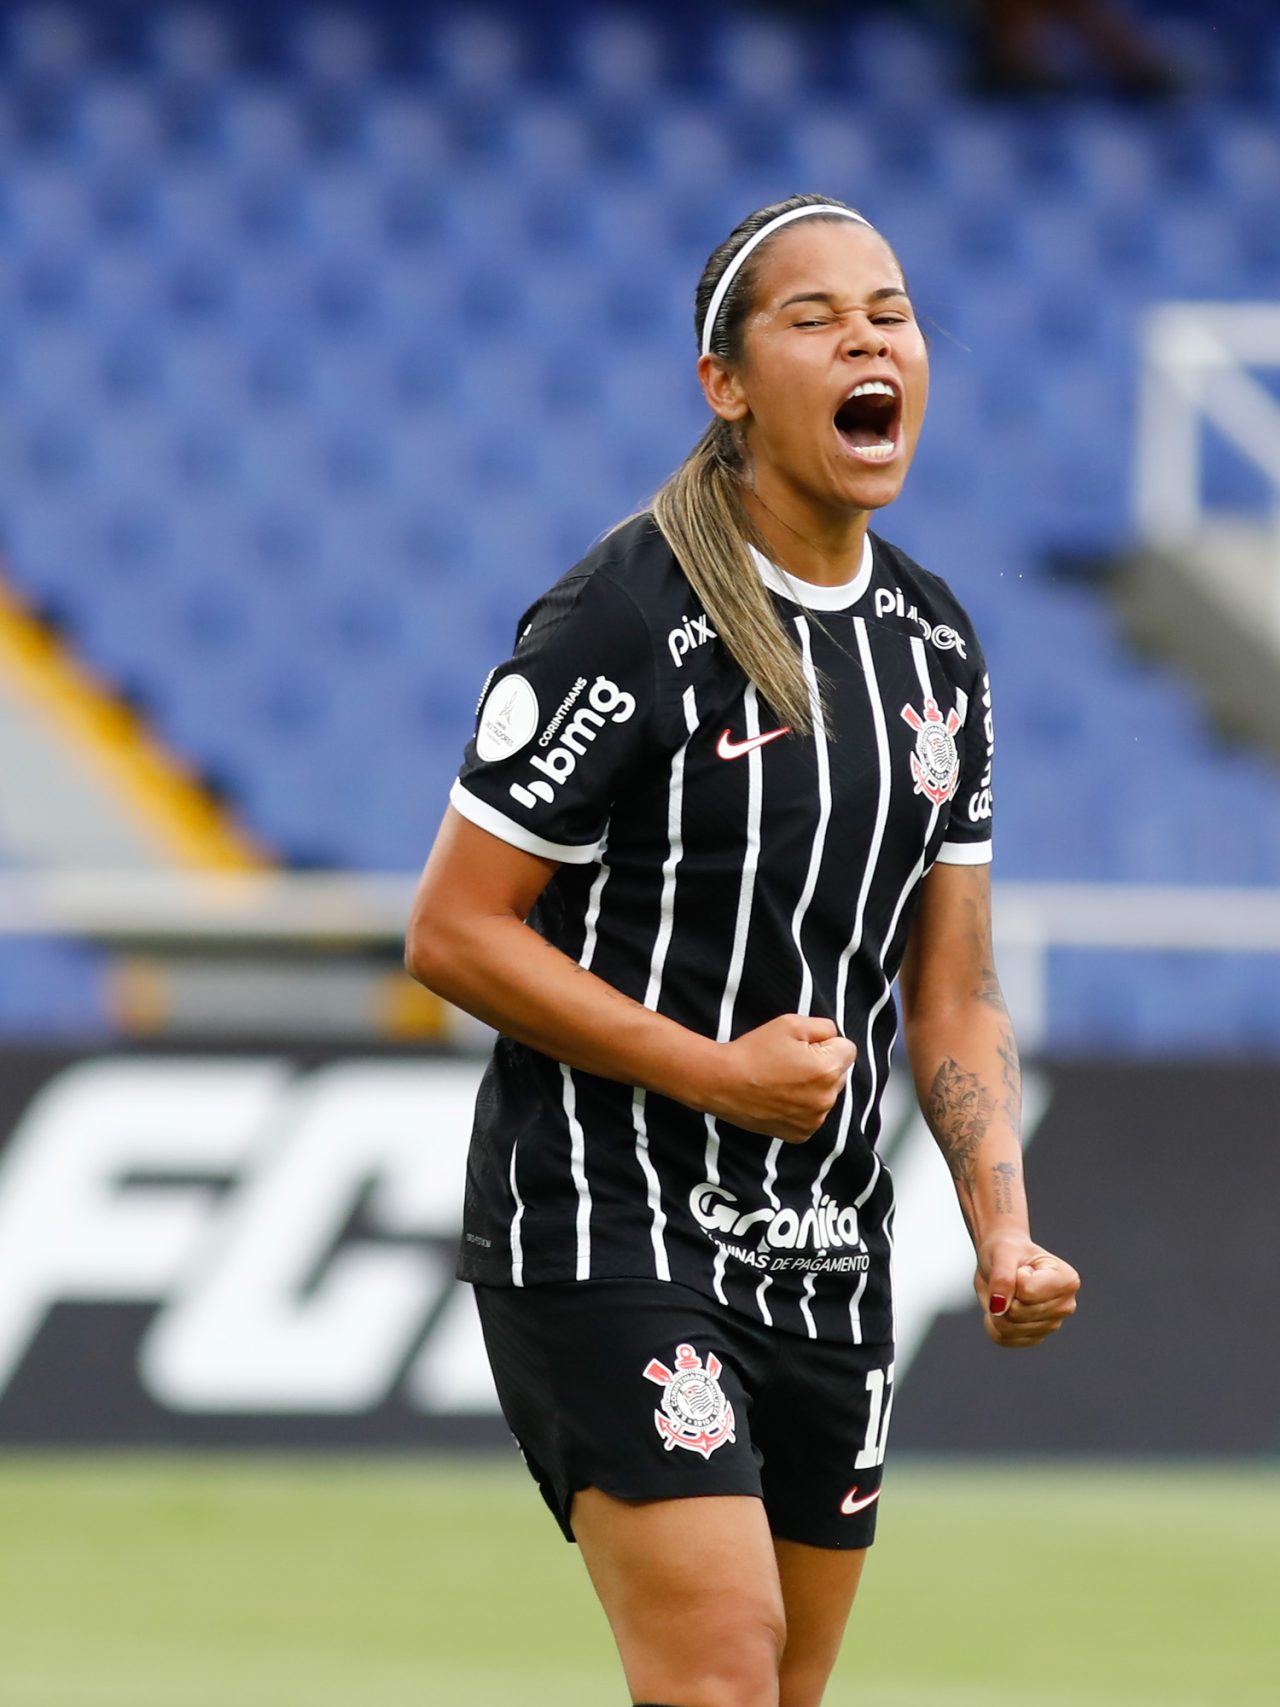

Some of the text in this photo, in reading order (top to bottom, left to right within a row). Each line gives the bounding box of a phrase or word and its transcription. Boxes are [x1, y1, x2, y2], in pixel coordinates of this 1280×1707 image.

[668, 614, 718, 668] pix
[529, 675, 637, 786] bmg
[538, 676, 588, 748] CORINTHIANS
[689, 1182, 860, 1249] Granito
[770, 1257, 792, 1271] DE
[791, 1254, 870, 1272] PAGAMENTO
